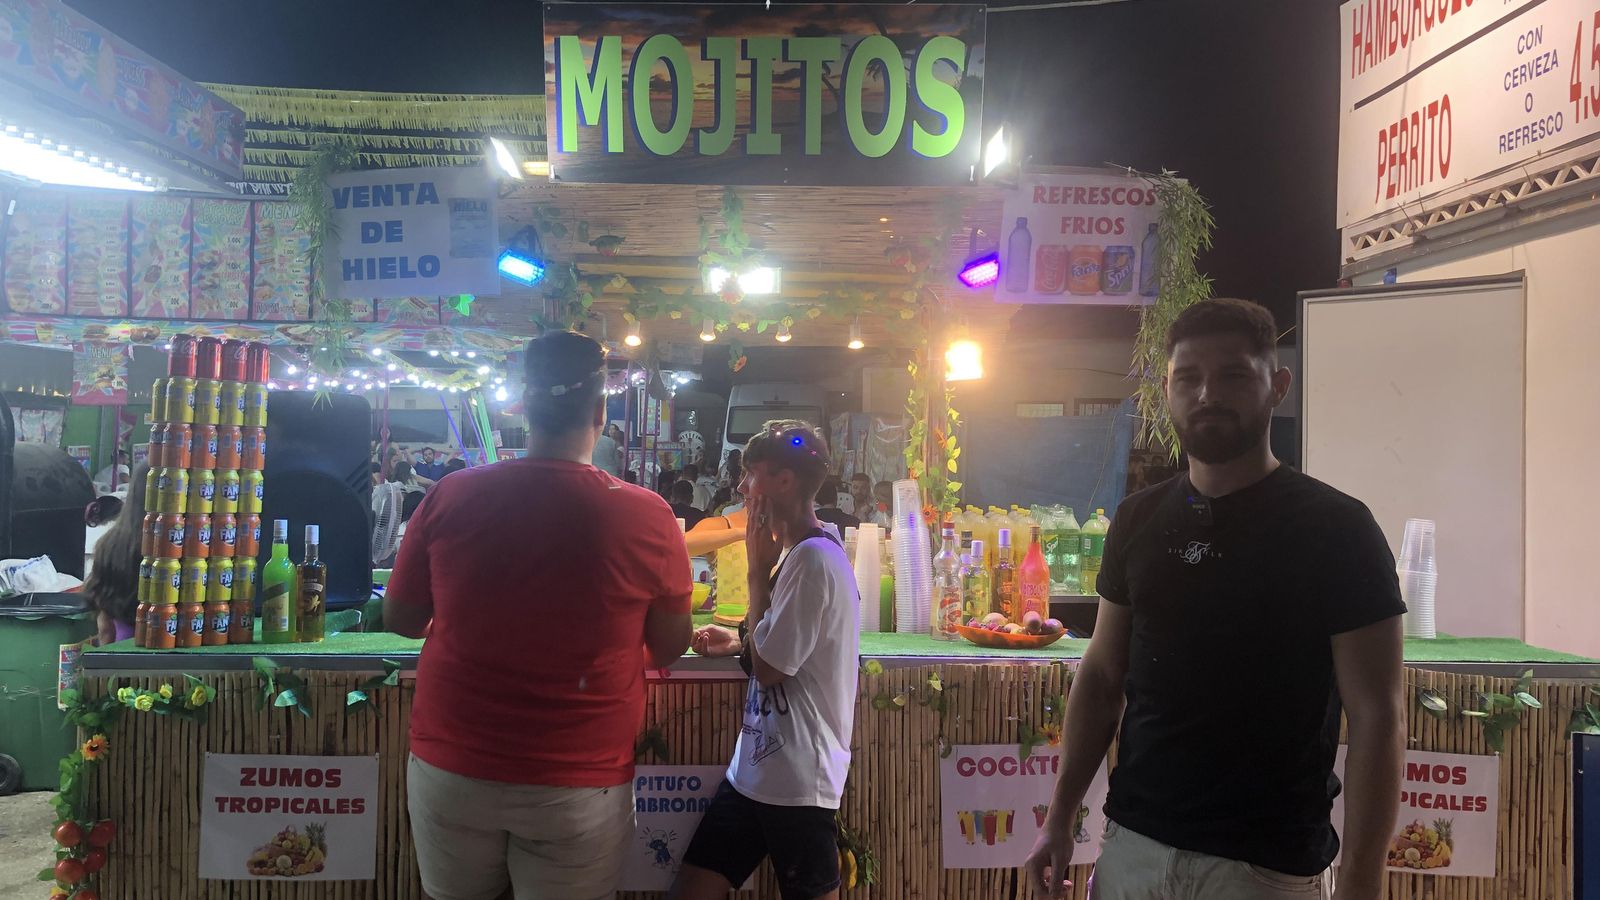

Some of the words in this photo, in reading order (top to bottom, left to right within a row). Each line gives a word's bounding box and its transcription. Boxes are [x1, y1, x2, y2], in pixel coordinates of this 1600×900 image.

[1517, 25, 1544, 55] CON
[1503, 49, 1559, 91] CERVEZA
[556, 34, 966, 157] MOJITOS
[1524, 92, 1534, 113] O
[1499, 111, 1564, 155] REFRESCO
[1375, 93, 1452, 204] PERRITO
[332, 182, 440, 210] VENTA
[1033, 185, 1157, 206] REFRESCOS
[361, 220, 404, 244] DE
[1060, 217, 1125, 235] FRIOS
[342, 255, 441, 281] HIELO
[240, 767, 342, 788] ZUMOS
[637, 775, 702, 792] PITUFO
[1402, 762, 1467, 786] MOS
[215, 796, 366, 815] TROPICALES
